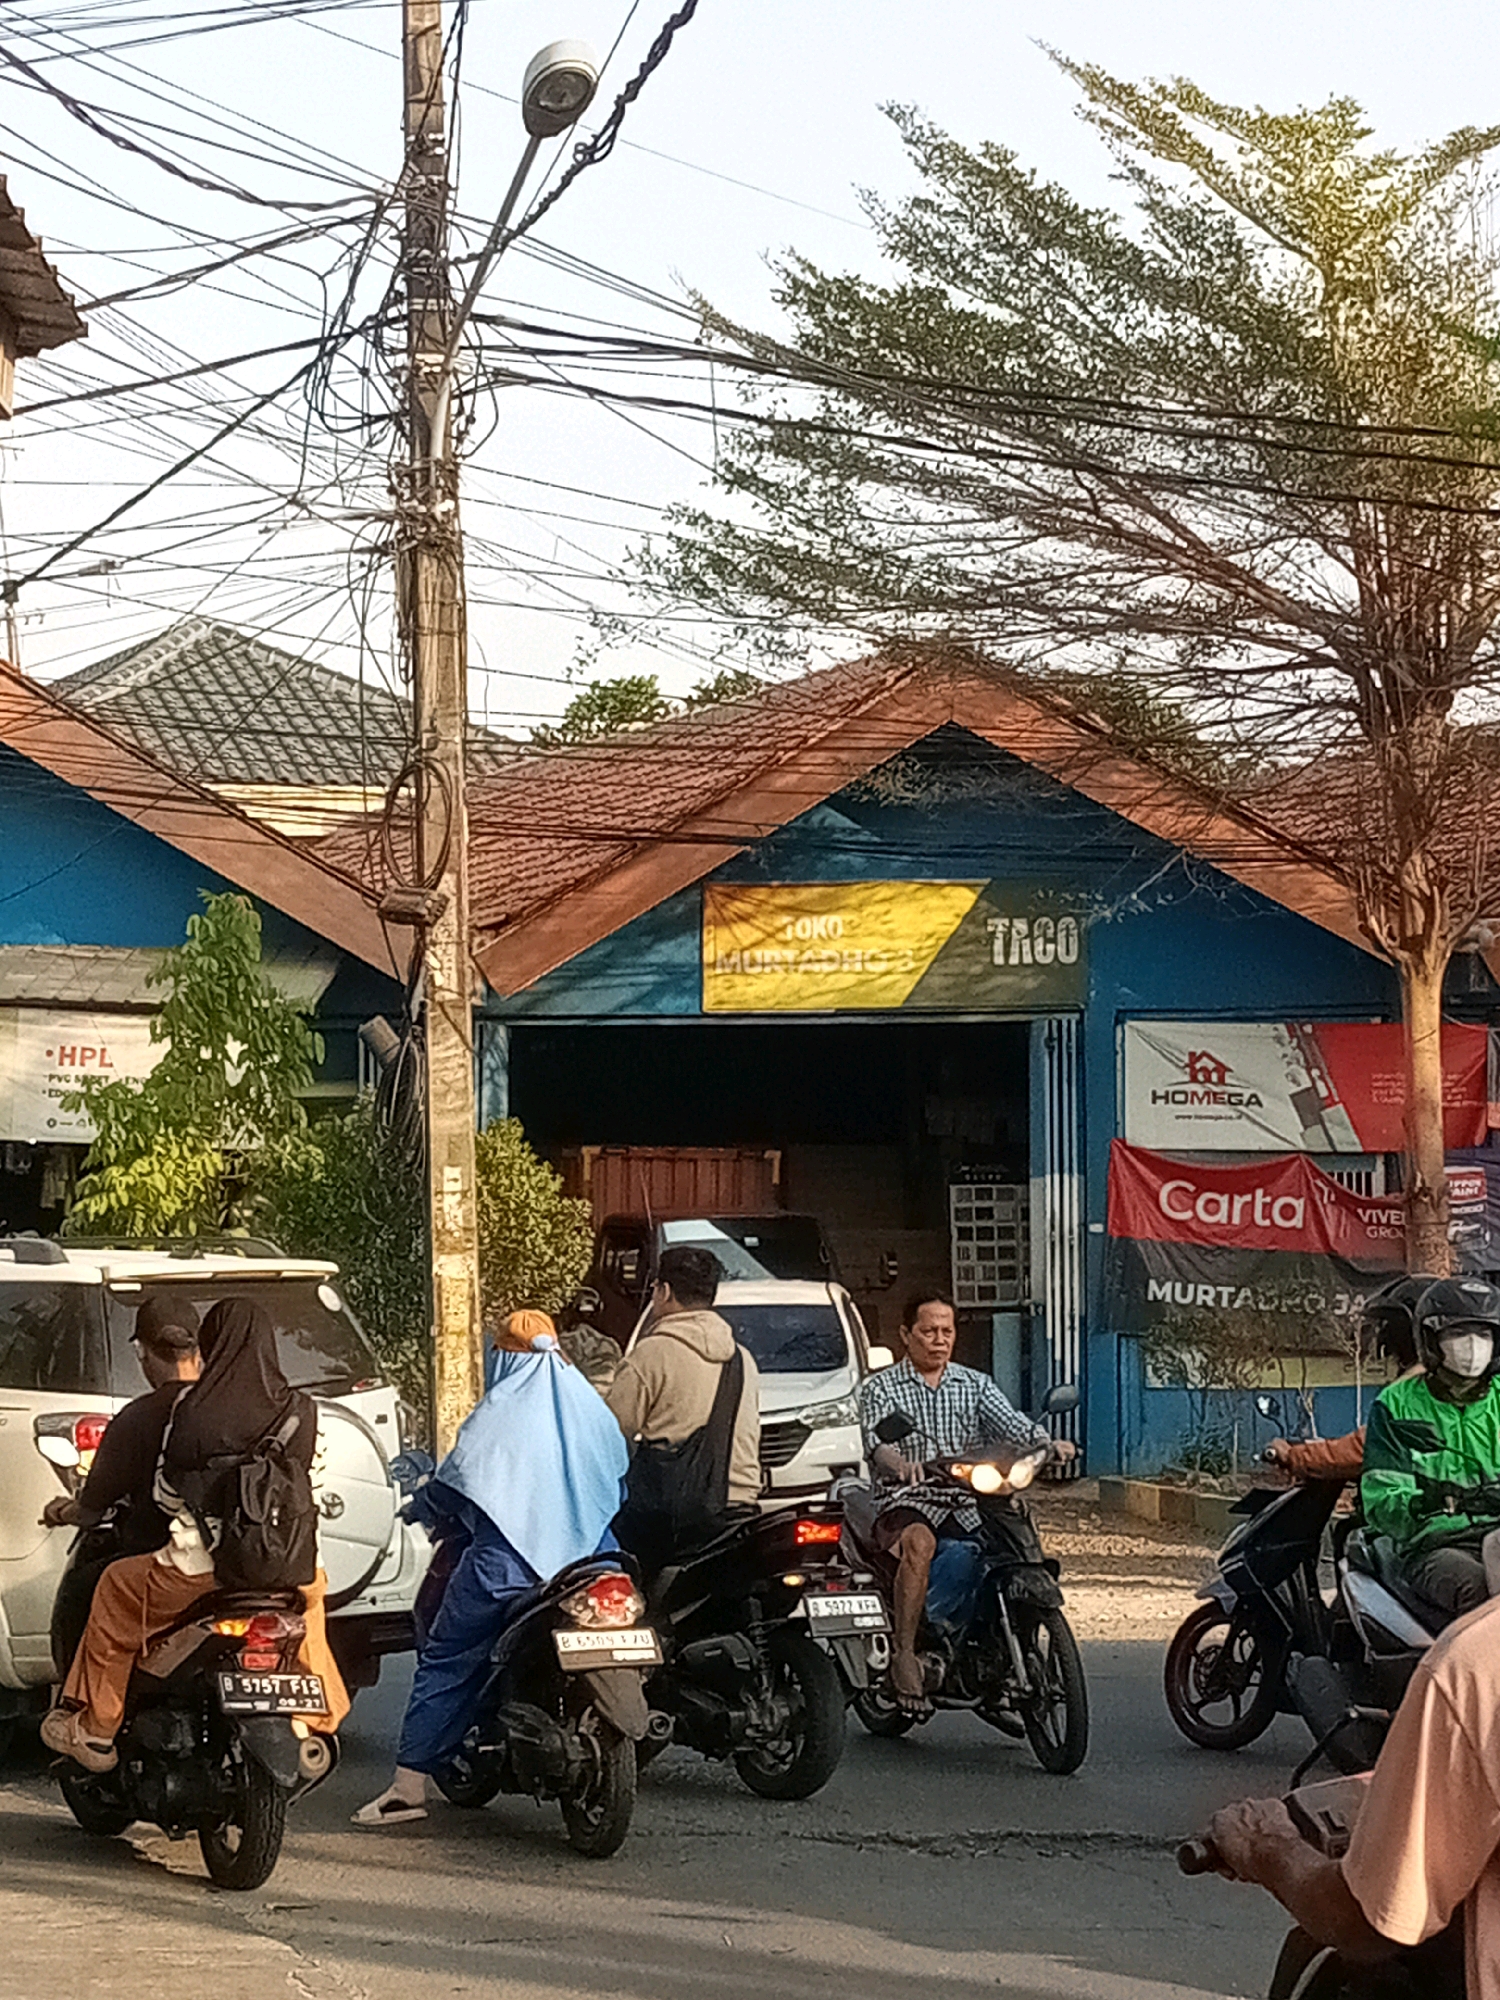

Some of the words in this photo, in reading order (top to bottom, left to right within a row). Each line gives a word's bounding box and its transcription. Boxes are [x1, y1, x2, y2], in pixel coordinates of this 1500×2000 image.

[781, 915, 844, 940] TOKO
[715, 949, 888, 974] MURTADHO
[58, 1046, 114, 1068] HPL
[1151, 1089, 1264, 1108] HOMEGA
[1159, 1180, 1305, 1229] Carta
[561, 1637, 571, 1649] B
[223, 1677, 234, 1692] B
[241, 1678, 280, 1695] 5757
